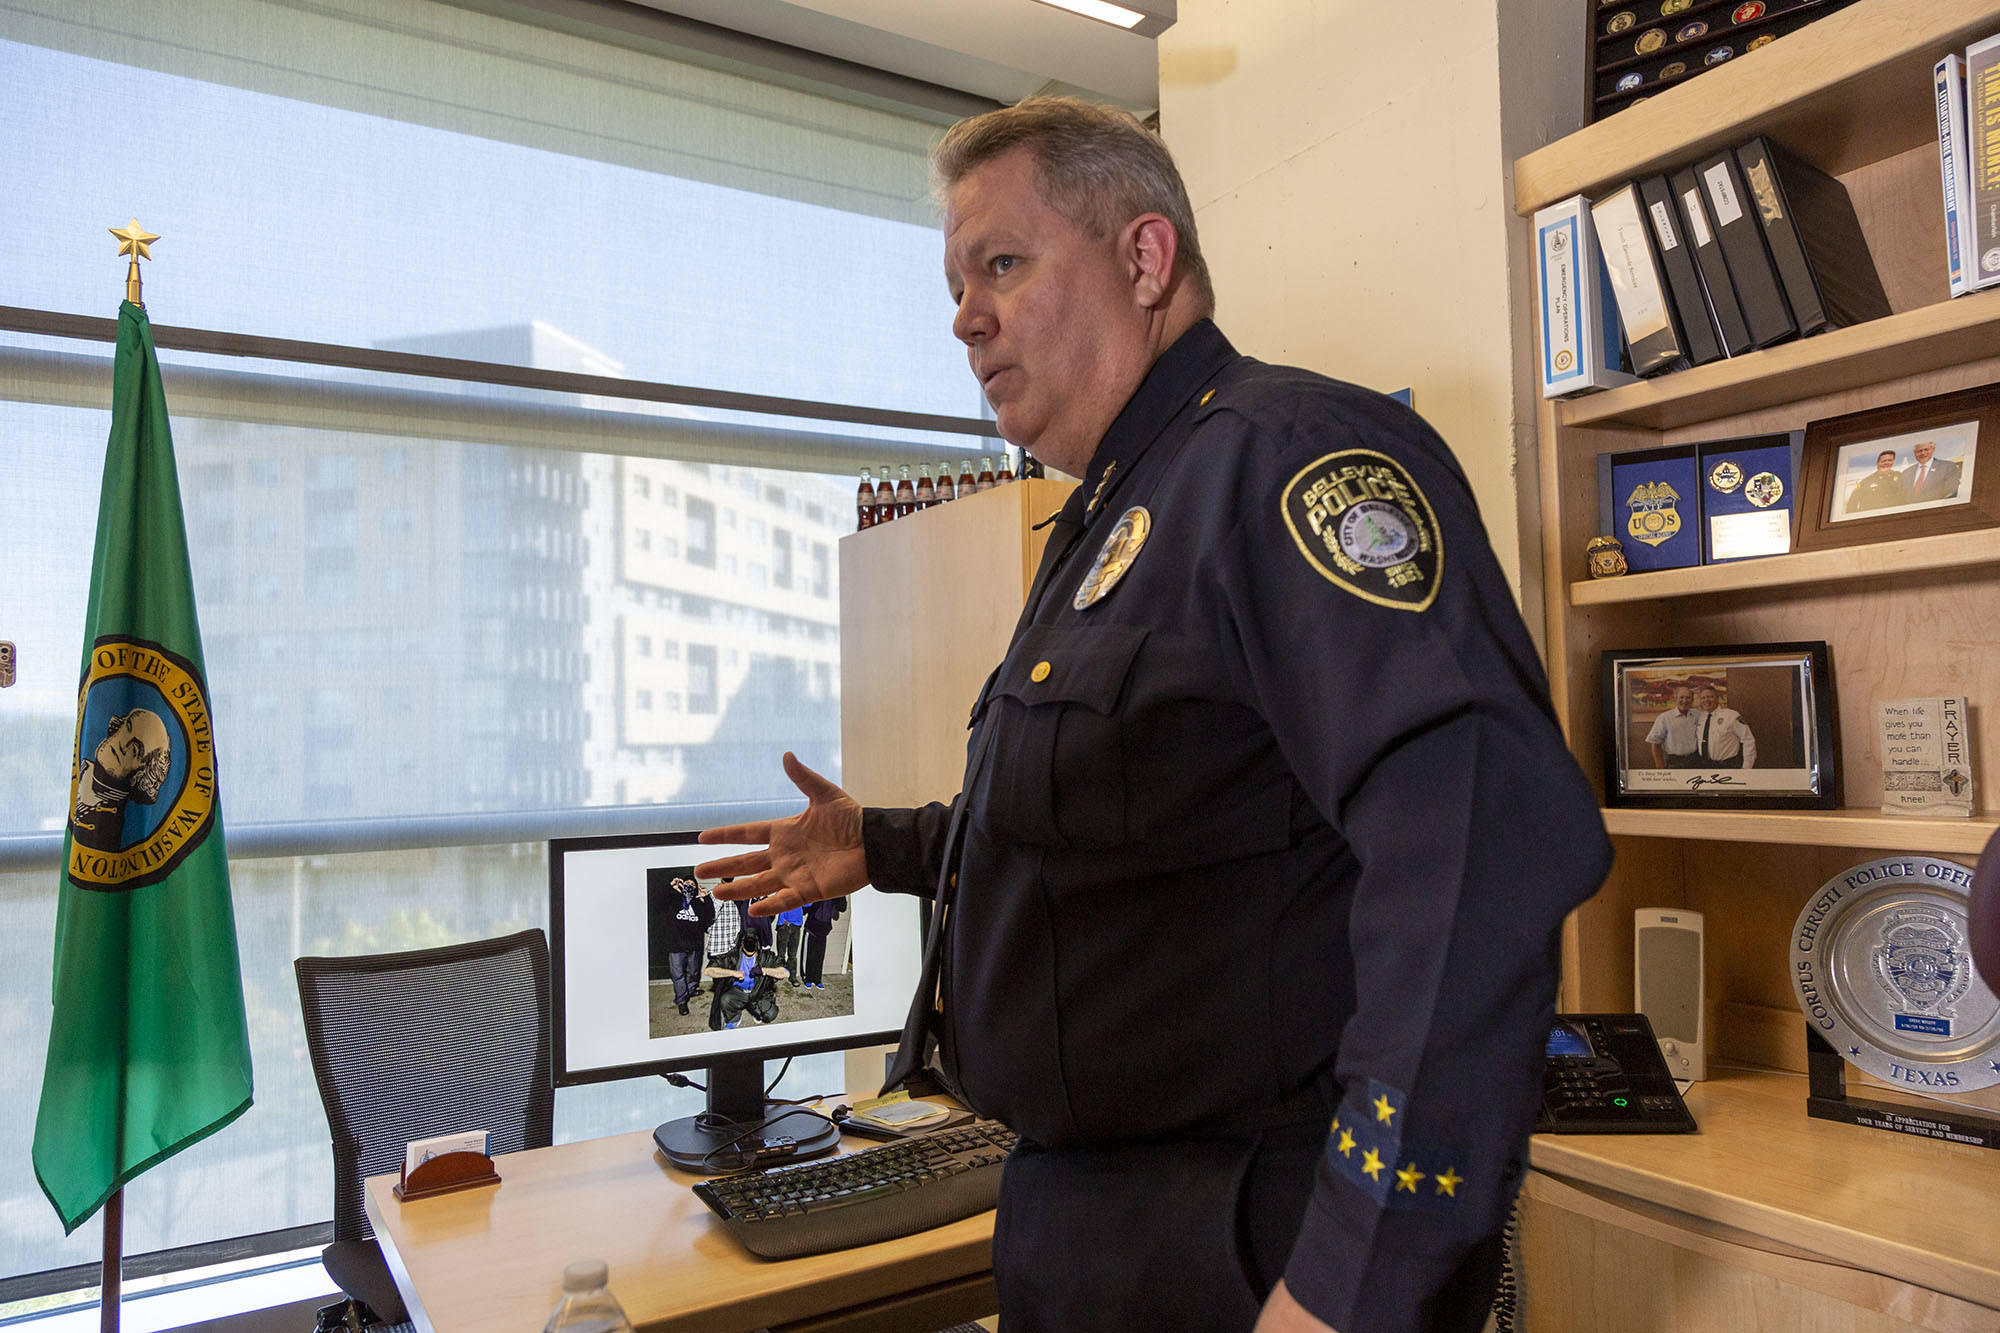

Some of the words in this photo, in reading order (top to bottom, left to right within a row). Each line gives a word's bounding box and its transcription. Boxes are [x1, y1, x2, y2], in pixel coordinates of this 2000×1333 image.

[1938, 88, 1951, 157] LITIGATION-FREE
[1944, 156, 1956, 213] MANAGEMENT
[1560, 263, 1568, 302] EMERGENCY
[1561, 302, 1570, 343] OPERATIONS
[1306, 477, 1417, 537] POLICE
[1632, 518, 1642, 530] U
[1666, 514, 1676, 526] S
[1343, 525, 1354, 546] CITY
[97, 648, 129, 669] OF
[131, 651, 170, 684] THE
[171, 681, 211, 753] STATE
[1885, 707, 1909, 716] When
[1912, 706, 1925, 716] life
[1885, 720, 1906, 731] gives
[1908, 720, 1923, 730] you
[1887, 732, 1907, 741] more
[1910, 731, 1932, 741] than
[1943, 699, 1960, 764] PRAYER
[1888, 745, 1903, 755] you
[1906, 745, 1922, 753] can
[193, 766, 213, 799] OF
[72, 808, 203, 879] WASHINGTON
[1844, 862, 1915, 890] POLICE
[1799, 888, 1843, 952] CHRISTI
[1797, 961, 1836, 1031] CORPUS
[1889, 1063, 1960, 1086] TEXAS
[1857, 1116, 1873, 1126] YOUR
[1874, 1119, 1894, 1130] YEARS
[1895, 1123, 1904, 1131] OF
[1904, 1124, 1930, 1136] SERVICE
[1931, 1129, 1945, 1139] AND
[1945, 1132, 1984, 1145] MEMBERSHIP
[1938, 1123, 1951, 1132] FOR
